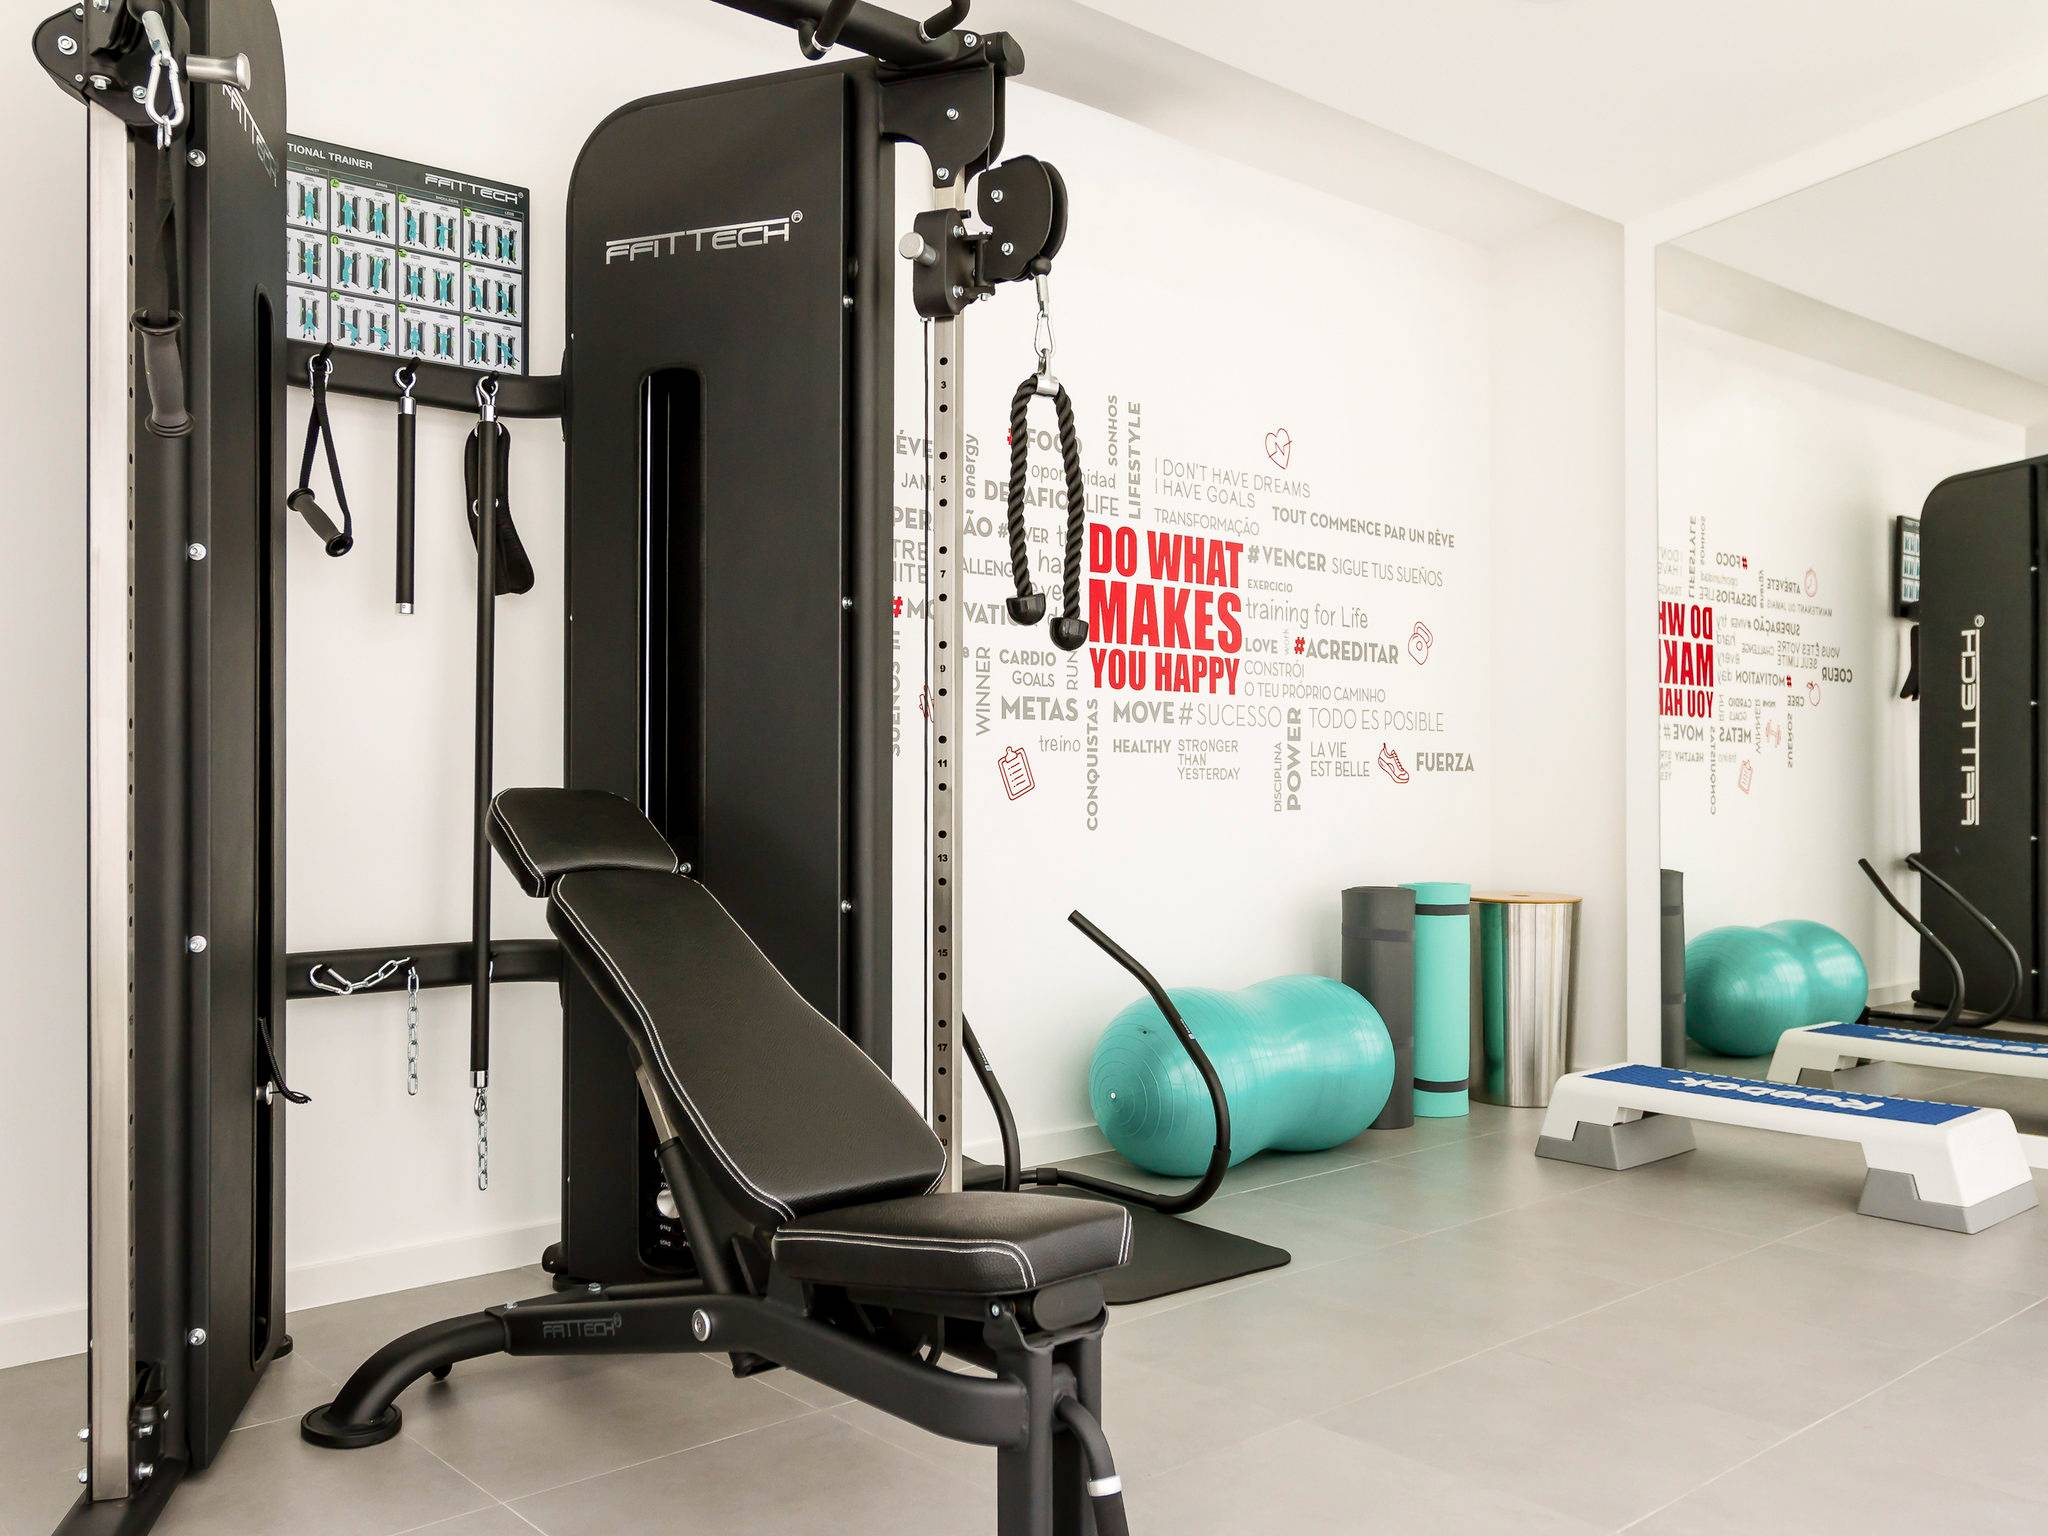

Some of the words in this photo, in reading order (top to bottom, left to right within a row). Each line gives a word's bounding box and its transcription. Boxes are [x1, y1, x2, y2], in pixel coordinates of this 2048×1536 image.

[328, 152, 373, 170] TRAINER
[941, 381, 947, 389] 3
[1108, 394, 1118, 467] SONHOS
[965, 434, 979, 499] energy
[1128, 402, 1141, 519] LIFESTYLE
[940, 475, 947, 483] 5
[1163, 459, 1208, 479] DON'T
[1212, 467, 1249, 489] HAVE
[1253, 474, 1311, 498] DREAMS
[1086, 495, 1119, 517] LIFE
[1162, 482, 1201, 501] HAVE
[1206, 486, 1256, 508] GOALS
[1154, 508, 1260, 536] TRANSFORMAÇÃO
[1272, 506, 1306, 526] TOUT
[1310, 512, 1381, 537] COMMENCE
[1384, 523, 1406, 540] PAR
[1409, 528, 1425, 543] UN
[1428, 528, 1455, 548] RÊVE
[1089, 522, 1138, 577] DO
[1147, 530, 1244, 588] WHAT
[940, 570, 946, 578] 7
[1332, 557, 1369, 578] SIGUE
[1371, 562, 1394, 582] TUS
[1396, 565, 1443, 587] SUEÑOS
[1248, 578, 1293, 592] EXERCICIO
[1088, 579, 1242, 654] MAKES
[1245, 596, 1309, 629] training
[1314, 603, 1336, 626] for
[1341, 606, 1369, 629] Life
[1245, 638, 1278, 654] LOVE
[1294, 637, 1399, 664] #ACREDITAR
[940, 664, 946, 673] 9
[1000, 649, 1056, 667] CARDIO
[1244, 659, 1305, 679] CONSTRÓI
[1012, 670, 1055, 688] GOALS
[1066, 651, 1079, 690] RUN
[1090, 648, 1146, 691] YOU
[1155, 653, 1240, 695] HAPPY
[976, 646, 990, 736] WINNER
[1244, 682, 1254, 697] O
[1257, 684, 1280, 699] TEU
[1282, 680, 1331, 701] PRÓPRIO
[1334, 687, 1386, 703] CAMINHO
[1001, 696, 1079, 721] METAS
[1113, 701, 1175, 724] MOVE
[1308, 707, 1357, 730] TODO
[1362, 710, 1379, 731] ES
[1384, 711, 1444, 732] POSIBLE
[1039, 735, 1081, 752] treino
[1113, 739, 1171, 754] HEALTHY
[1178, 739, 1239, 753] STRONGER
[1310, 742, 1326, 758] LA
[1327, 742, 1347, 758] VIE
[937, 759, 948, 768] 11
[1086, 698, 1099, 831] CONQUISTAS
[1178, 753, 1206, 766] THAN
[1287, 707, 1301, 811] POWER
[1310, 762, 1332, 777] EST
[1335, 762, 1370, 778] BELLE
[1416, 752, 1475, 772] FUERZA
[1178, 767, 1241, 781] YESTERDAY
[1273, 742, 1282, 813] DISCIPLINA
[937, 854, 948, 862] 13
[937, 949, 948, 957] 15
[937, 1043, 948, 1052] 17
